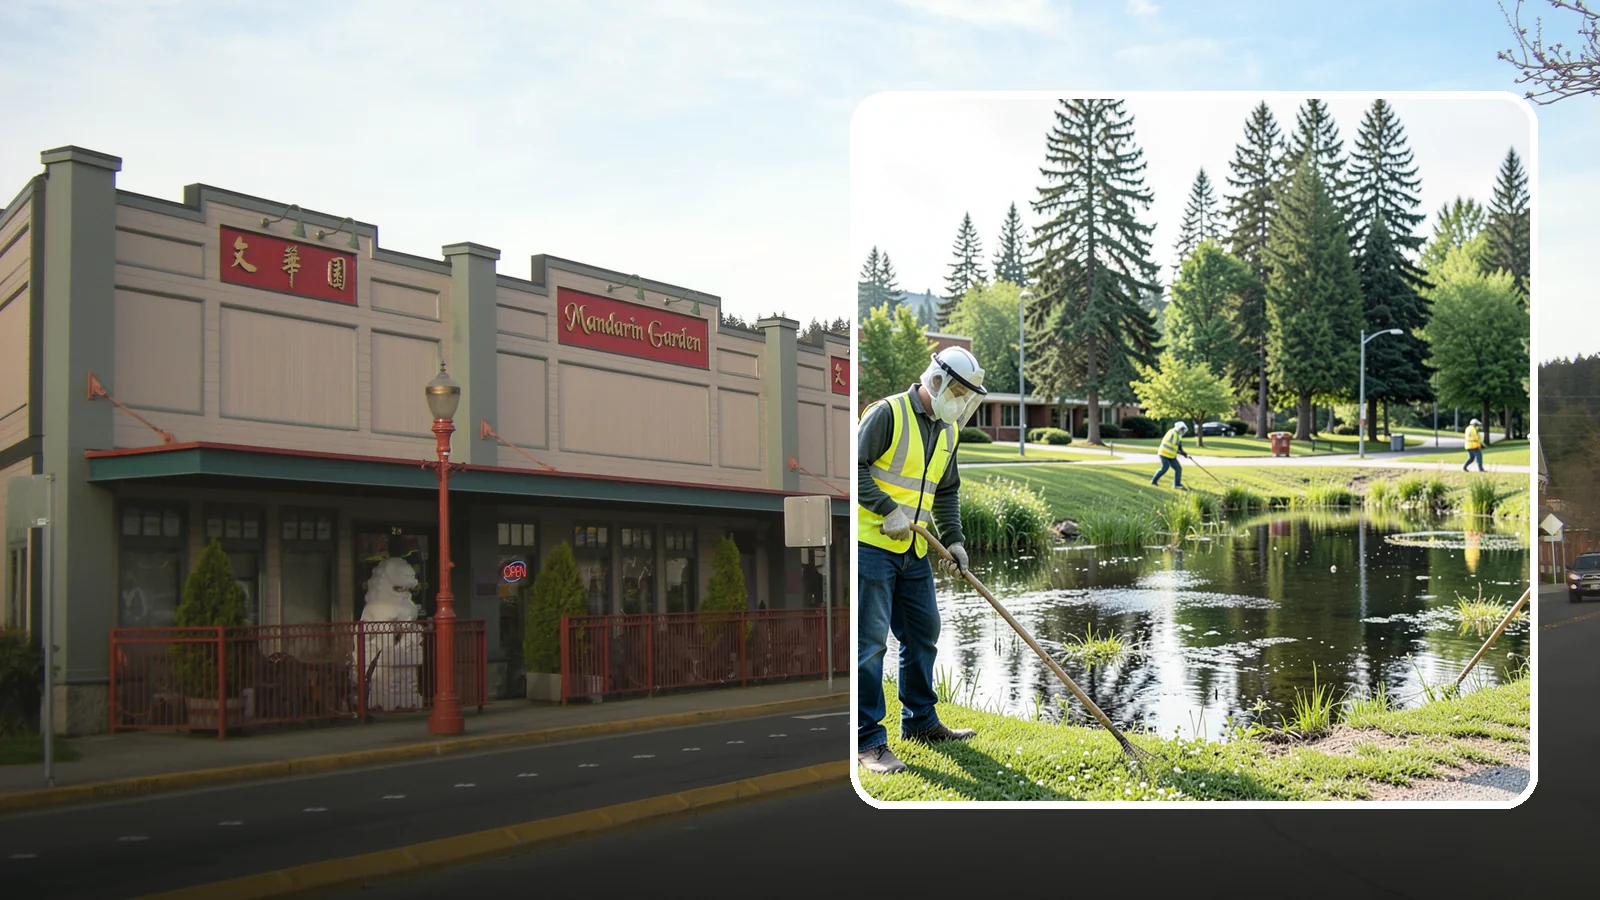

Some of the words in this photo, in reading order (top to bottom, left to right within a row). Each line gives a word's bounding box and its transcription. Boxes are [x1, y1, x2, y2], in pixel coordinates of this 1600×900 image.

[231, 236, 346, 290] 文華園
[564, 302, 644, 340] Mandarin
[648, 320, 701, 352] Garden
[835, 363, 846, 386] 文
[503, 565, 527, 578] OPEN
